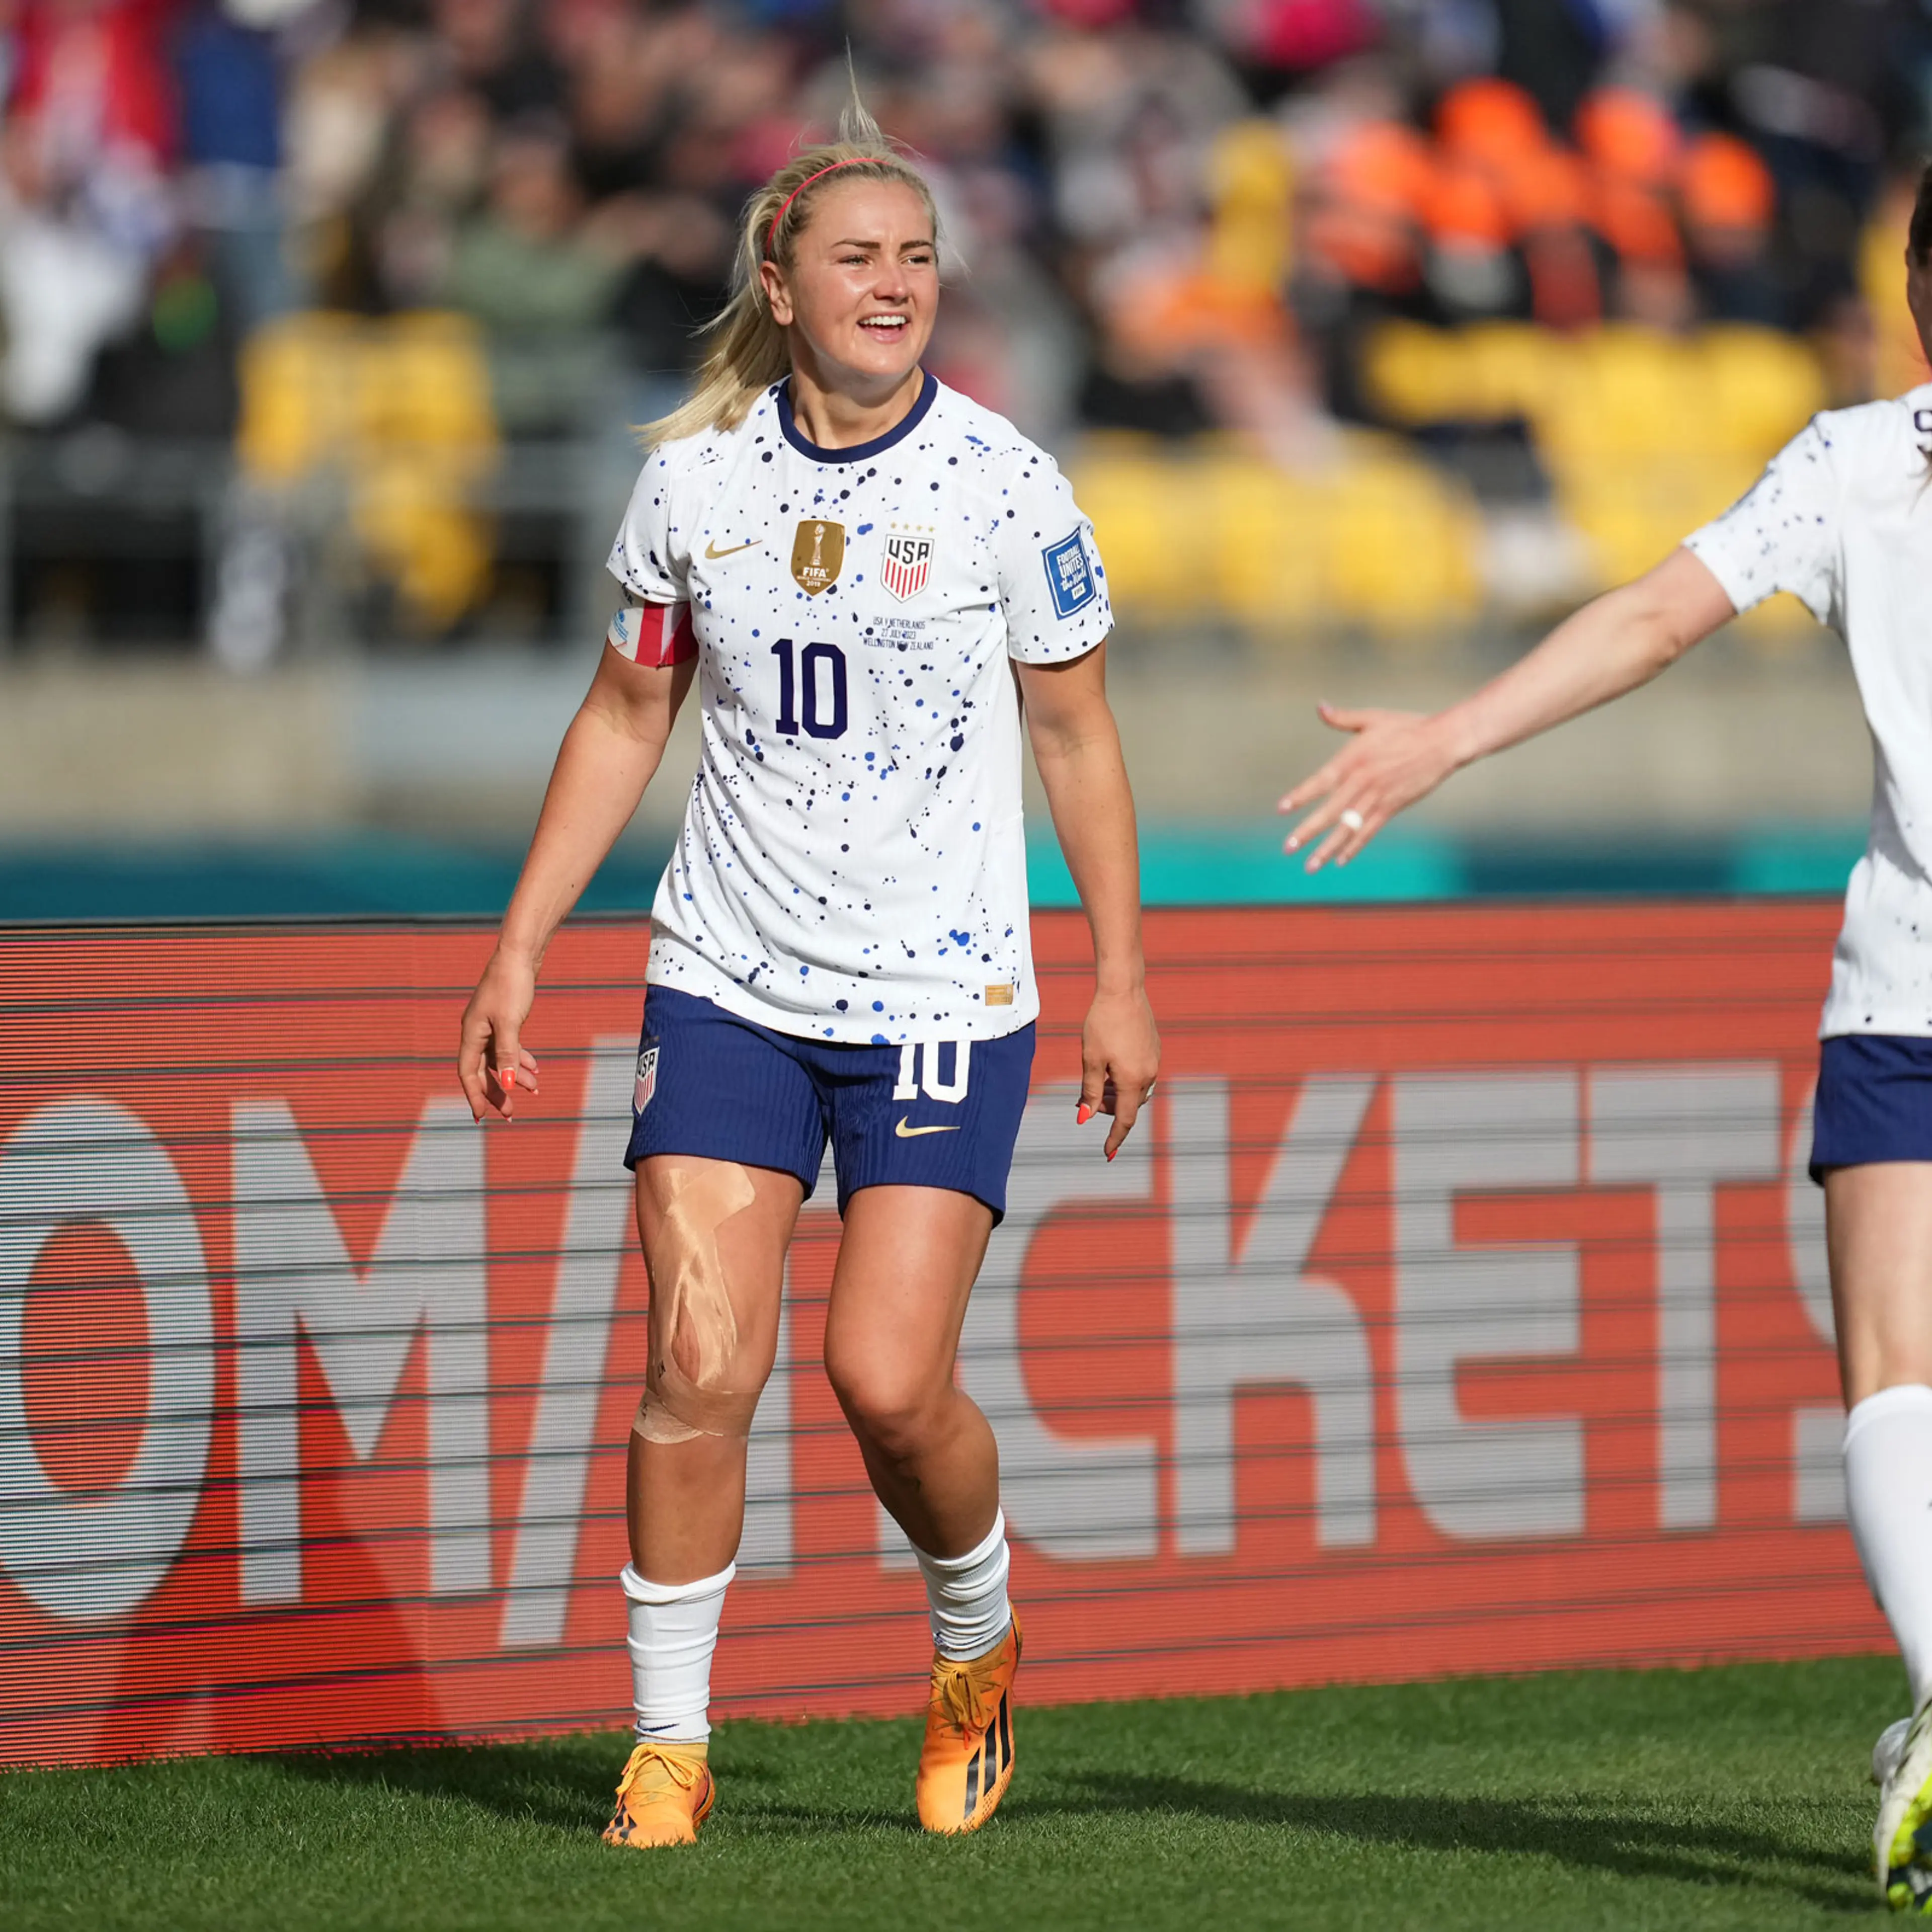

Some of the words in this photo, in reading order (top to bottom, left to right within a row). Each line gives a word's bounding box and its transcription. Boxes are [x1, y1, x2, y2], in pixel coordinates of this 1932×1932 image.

[889, 539, 929, 564] USA
[802, 567, 826, 578] FIFA
[890, 618, 925, 629] NETHERLANDS
[910, 641, 934, 650] ZEALAND
[771, 638, 848, 740] 10
[892, 1040, 971, 1104] 10
